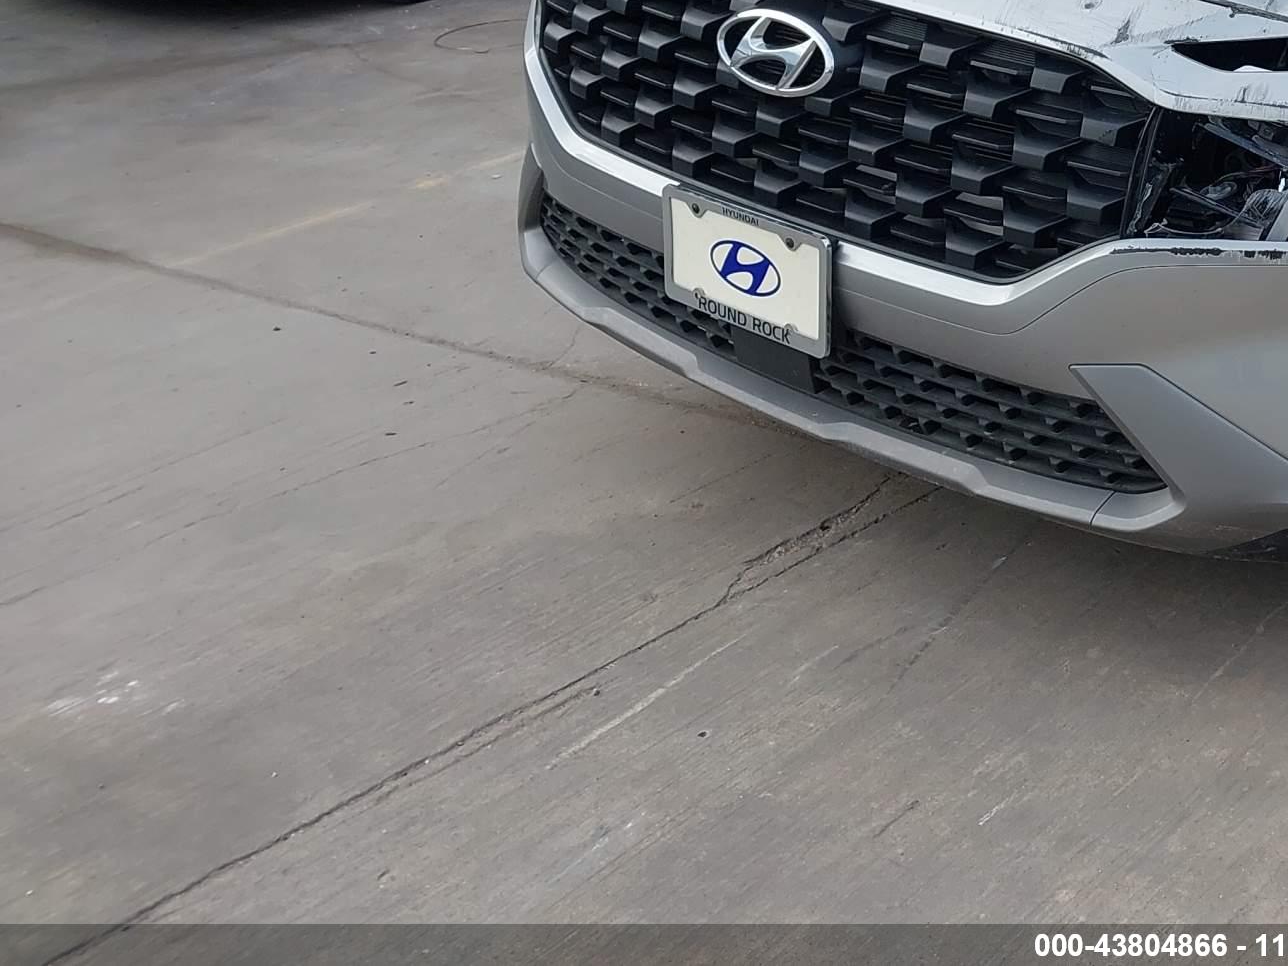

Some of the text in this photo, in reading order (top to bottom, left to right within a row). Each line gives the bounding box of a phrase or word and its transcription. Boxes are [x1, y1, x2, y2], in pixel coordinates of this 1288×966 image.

[721, 206, 760, 227] HYUNDAI
[698, 295, 791, 345] ROUND ROCK
